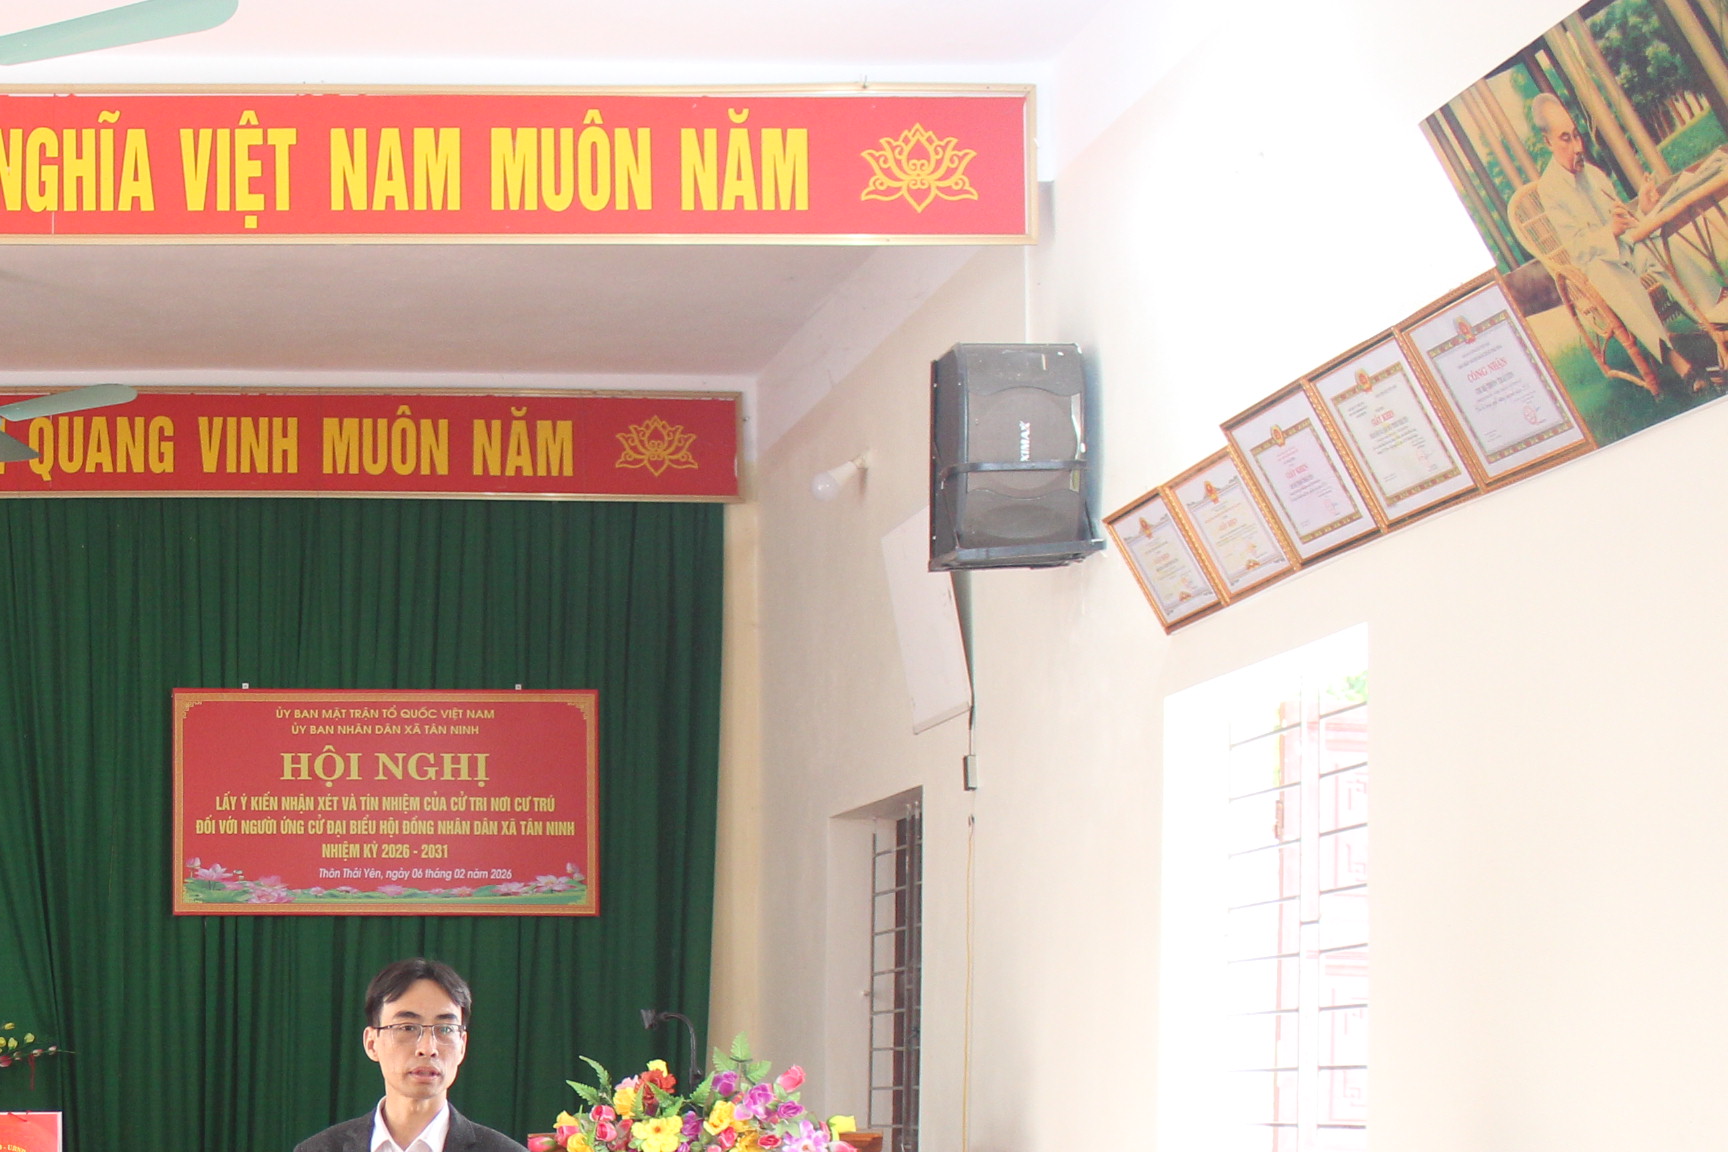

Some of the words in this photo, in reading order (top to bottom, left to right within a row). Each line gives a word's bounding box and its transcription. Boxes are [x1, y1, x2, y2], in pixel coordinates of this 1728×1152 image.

[180, 110, 298, 229] VIỆT
[330, 127, 461, 211] NAM
[491, 110, 652, 211] MUÔN
[681, 108, 808, 211] NĂM
[28, 416, 175, 481] QUANG
[198, 416, 298, 473] VINH
[322, 405, 449, 475] MUÔN
[473, 407, 574, 476] NĂM
[276, 706, 291, 718] ỦY
[294, 710, 318, 718] BAN
[322, 707, 346, 720] MẶT
[349, 707, 378, 720] TRẬN
[382, 705, 397, 718] TỔ
[400, 707, 437, 718] QUỐC
[441, 708, 463, 720] VIỆT
[467, 710, 494, 718] NAM
[292, 722, 306, 734] ỦY
[310, 726, 334, 734] BAN
[338, 723, 371, 734] NHÂN
[376, 723, 400, 734] DÂN
[404, 723, 421, 734] XÃ
[424, 723, 446, 734] TÂN
[450, 726, 478, 734] NINH
[280, 745, 362, 787] HỘI
[374, 753, 489, 787] NGHỊ
[216, 792, 237, 810] LẤY
[241, 794, 247, 810] Ý
[251, 792, 278, 810] KIẾN
[282, 794, 314, 814] NHẬN
[318, 794, 339, 810] XÉT
[342, 794, 357, 810] VÀ
[360, 794, 379, 810] TÍN
[382, 794, 420, 814] NHIỆM
[424, 791, 447, 811] CỦA
[450, 791, 468, 811] CỬ
[469, 797, 487, 811] TRI
[491, 796, 510, 811] NƠI
[514, 796, 531, 811] CƯ
[533, 795, 554, 812] TRÚ
[196, 815, 215, 834] ĐỐI
[219, 816, 237, 834] VỚI
[241, 816, 276, 834] NGƯỜI
[280, 816, 304, 834] ỨNG
[308, 814, 325, 834] CỬ
[326, 820, 346, 837] ĐẠI
[350, 814, 376, 834] BIỂU
[380, 817, 399, 837] HỘI
[402, 816, 434, 834] ĐỒNG
[438, 818, 470, 834] NHÂN
[474, 818, 498, 835] DÂN
[502, 819, 516, 835] XÃ
[520, 818, 542, 835] TÂN
[546, 822, 574, 835] NINH
[322, 841, 360, 861] NHIỆM
[364, 841, 378, 858] KỲ
[382, 844, 410, 858] 2026
[421, 844, 448, 858] 2031
[320, 868, 340, 878] Thôn
[343, 868, 361, 878] Thái
[364, 868, 383, 879] Yên,
[386, 868, 410, 880] ngày
[412, 868, 423, 878] 06
[425, 868, 452, 881] tháng
[454, 869, 465, 878] 02
[467, 869, 488, 878] năm
[491, 868, 512, 879] 2026
